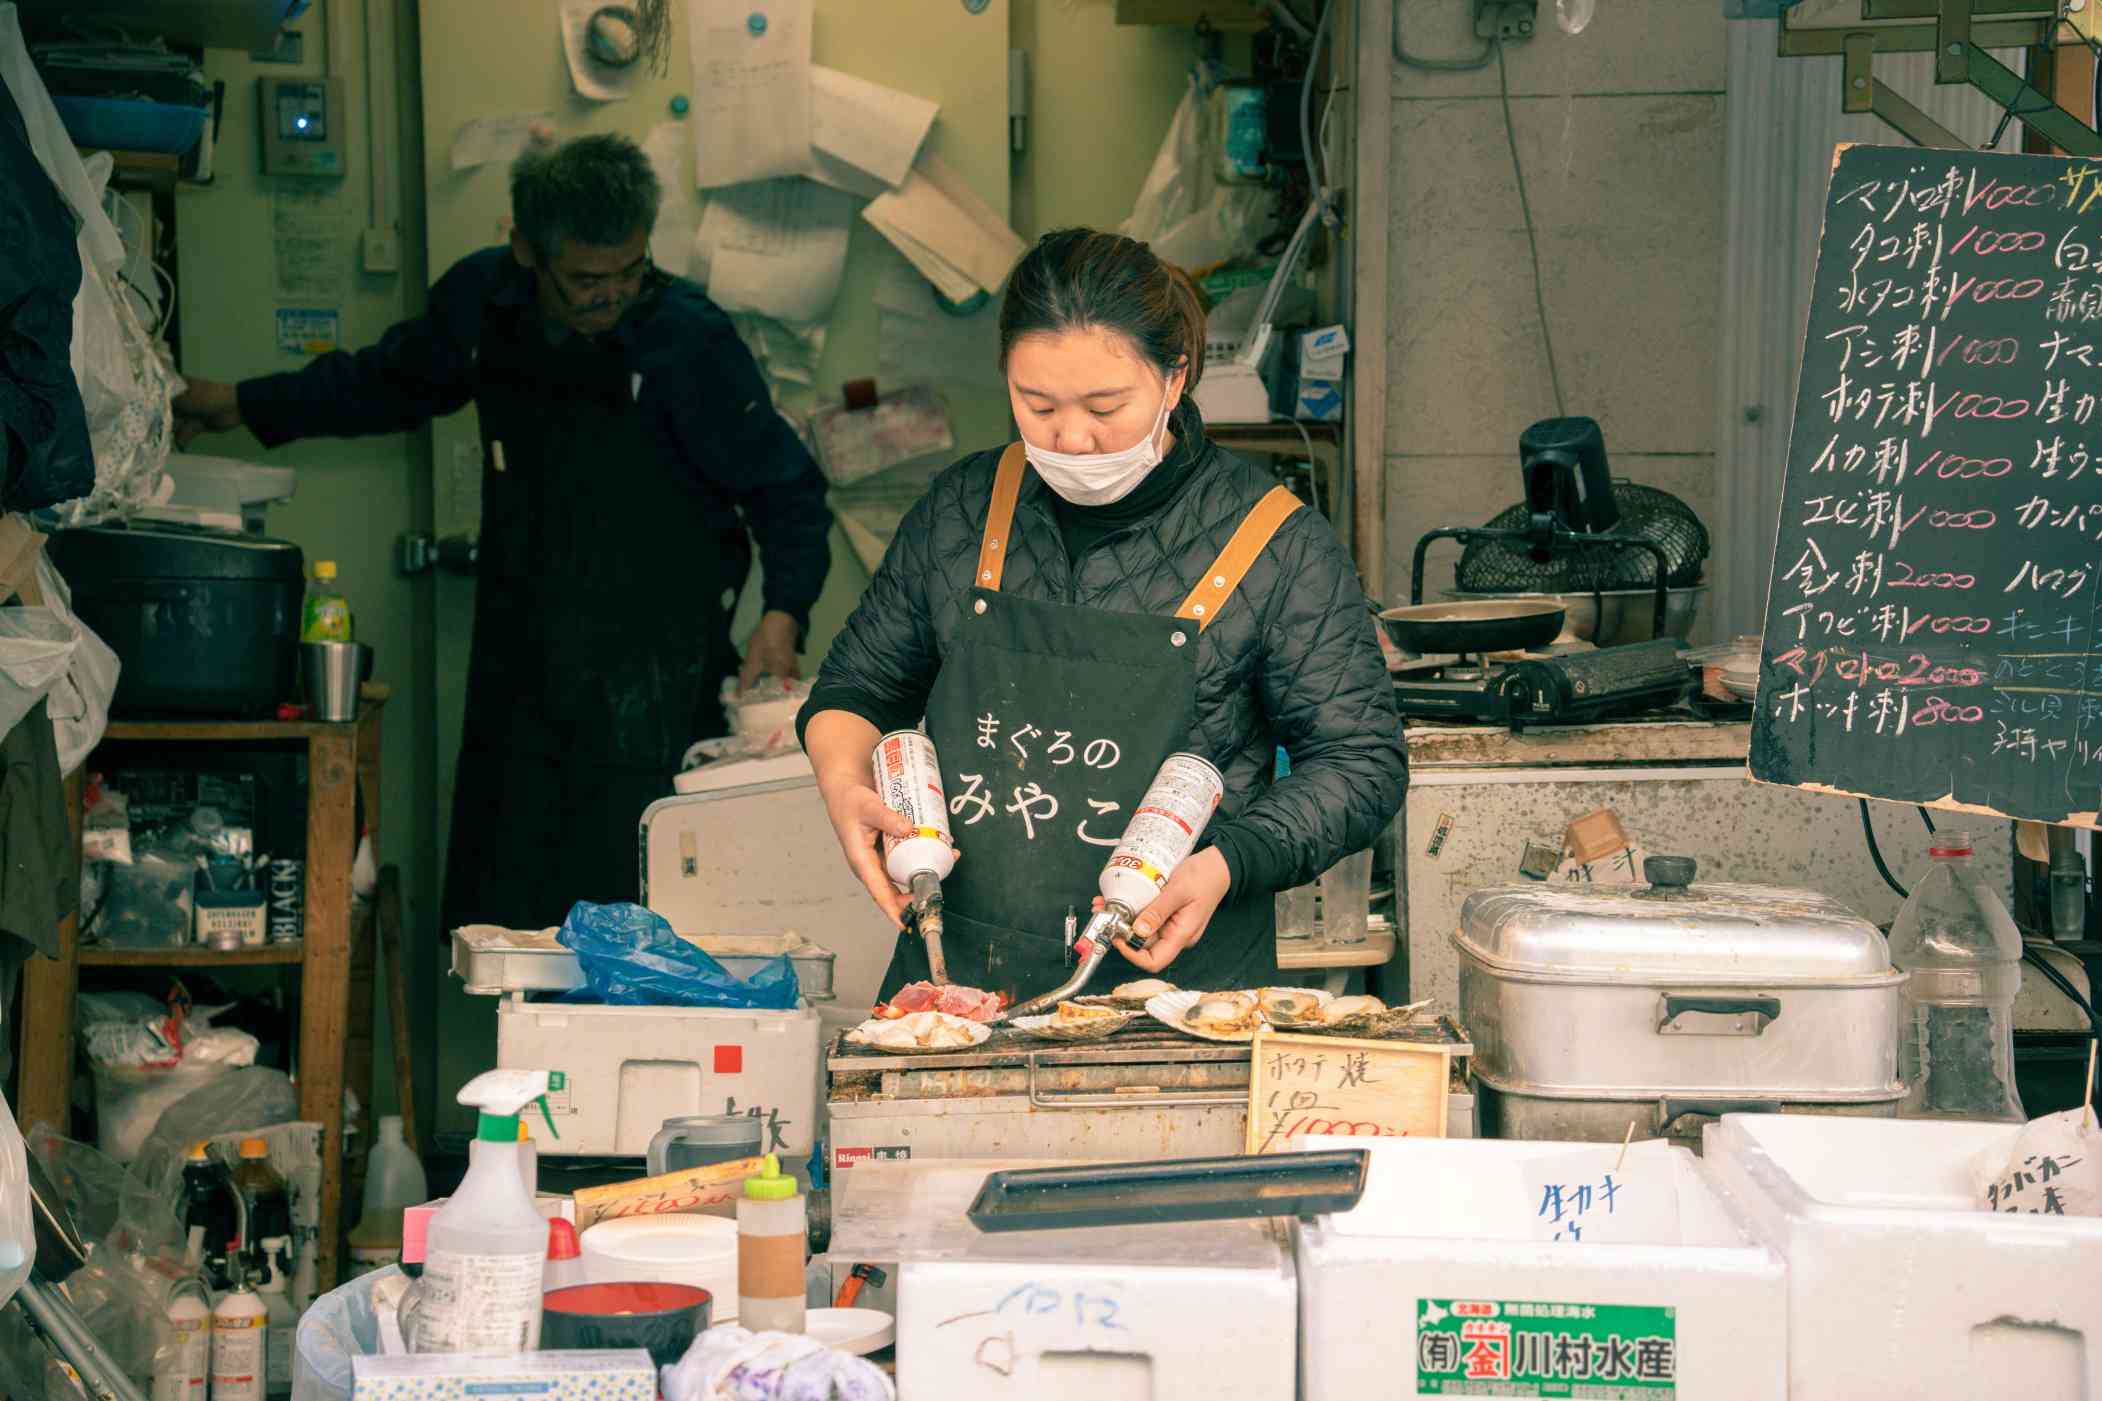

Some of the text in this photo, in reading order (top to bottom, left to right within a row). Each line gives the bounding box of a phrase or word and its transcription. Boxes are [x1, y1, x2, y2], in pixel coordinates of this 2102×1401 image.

[1967, 178, 2056, 210] 1000
[1850, 222, 2045, 272] タコ刺 1000
[2055, 225, 2102, 273] 白
[1947, 277, 2044, 306] 1000
[1937, 335, 2019, 366] 1000
[2039, 331, 2102, 371] ナマ
[1932, 391, 2030, 419] 1000
[1809, 434, 2013, 487] イカ刺 1000
[2030, 435, 2102, 481] 生ウ
[1802, 488, 1997, 550] エビ刺 1000
[2015, 495, 2102, 541] カンパ
[1887, 561, 1976, 589] 2000
[1906, 613, 1991, 634] 1000
[1911, 695, 1984, 726] 800
[976, 712, 1121, 769] まぐろの
[950, 773, 1122, 847] みやこ
